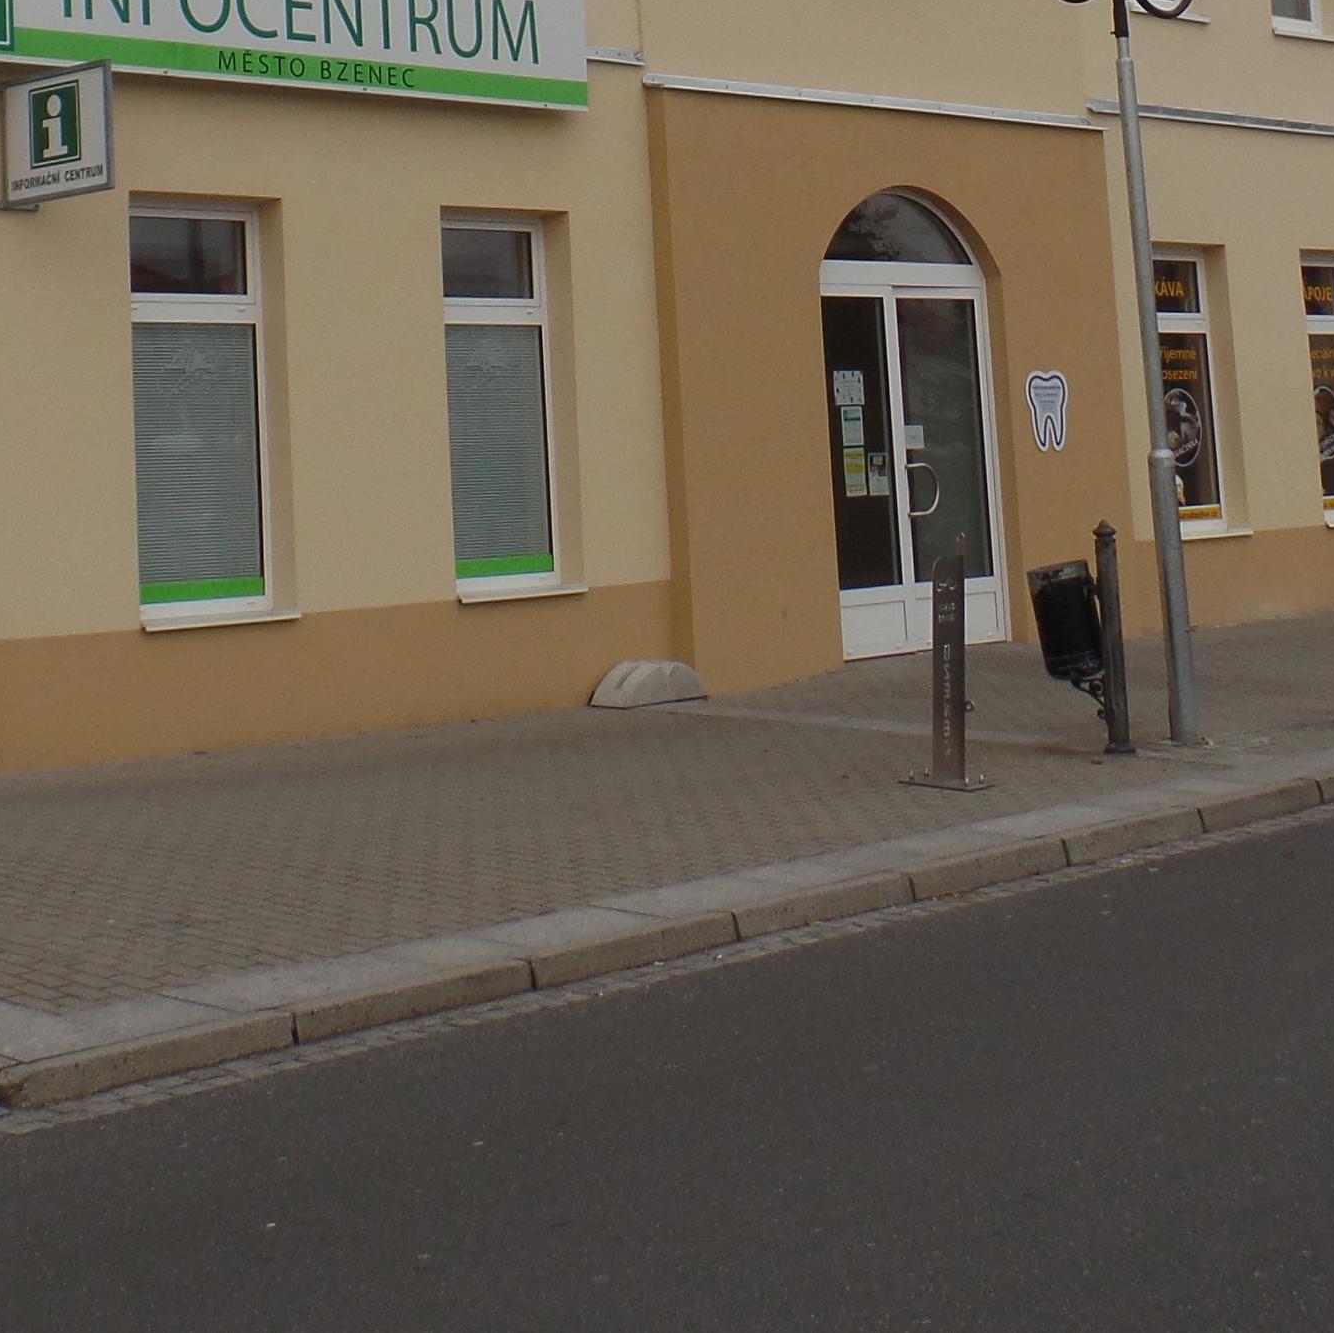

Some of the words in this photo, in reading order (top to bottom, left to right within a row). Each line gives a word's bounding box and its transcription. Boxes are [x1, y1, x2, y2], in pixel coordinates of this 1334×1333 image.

[218, 49, 305, 78] MĚSTO
[320, 61, 416, 89] BZENEC
[11, 170, 60, 191] INFORMAČNÍ
[64, 164, 104, 182] CENTRUM
[1154, 276, 1184, 296] KÁVA
